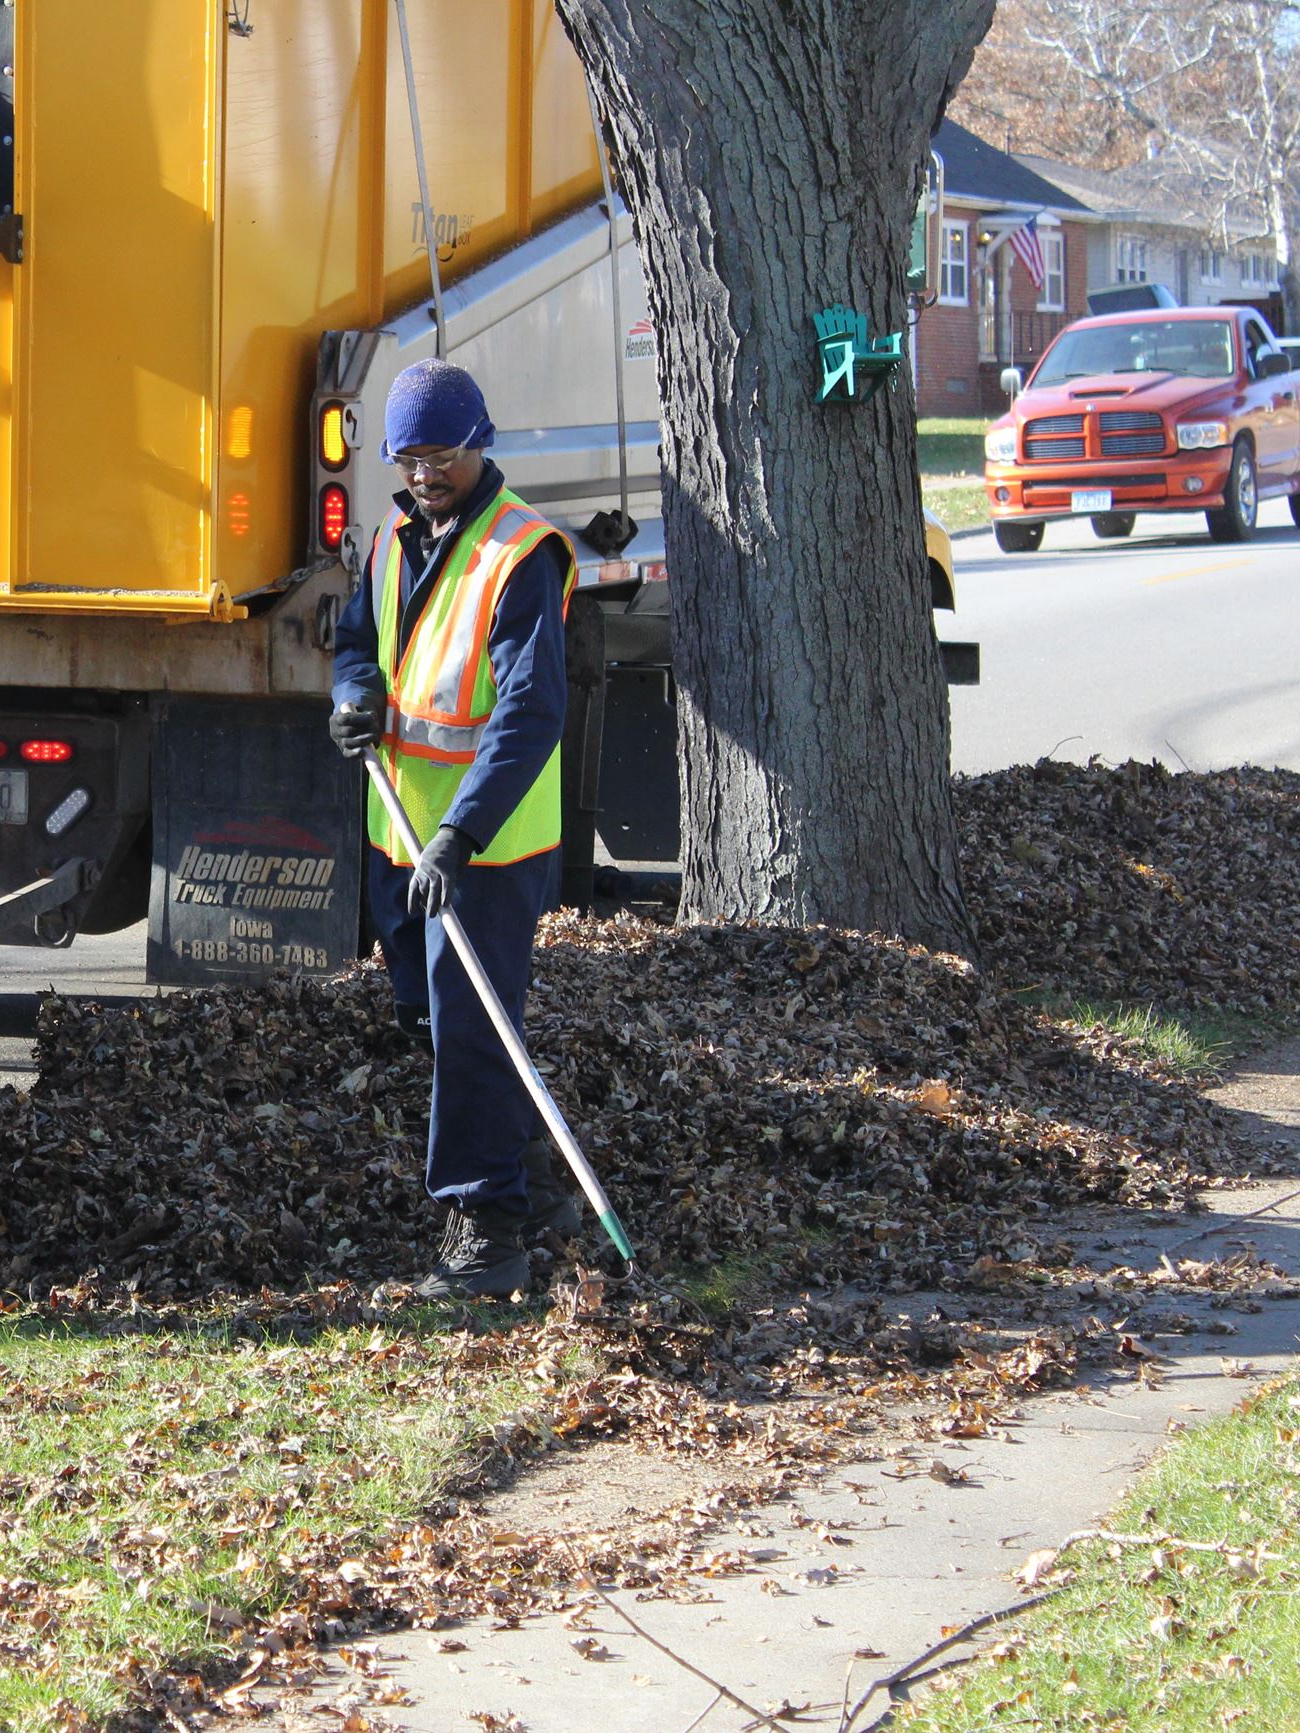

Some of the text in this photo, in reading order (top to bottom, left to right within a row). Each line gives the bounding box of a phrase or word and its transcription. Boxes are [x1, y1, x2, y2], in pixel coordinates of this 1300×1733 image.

[176, 846, 336, 887] Henderson
[173, 879, 337, 911] Truck Equipment
[229, 916, 274, 939] Iowa
[174, 938, 329, 969] 1-888-360-7483
